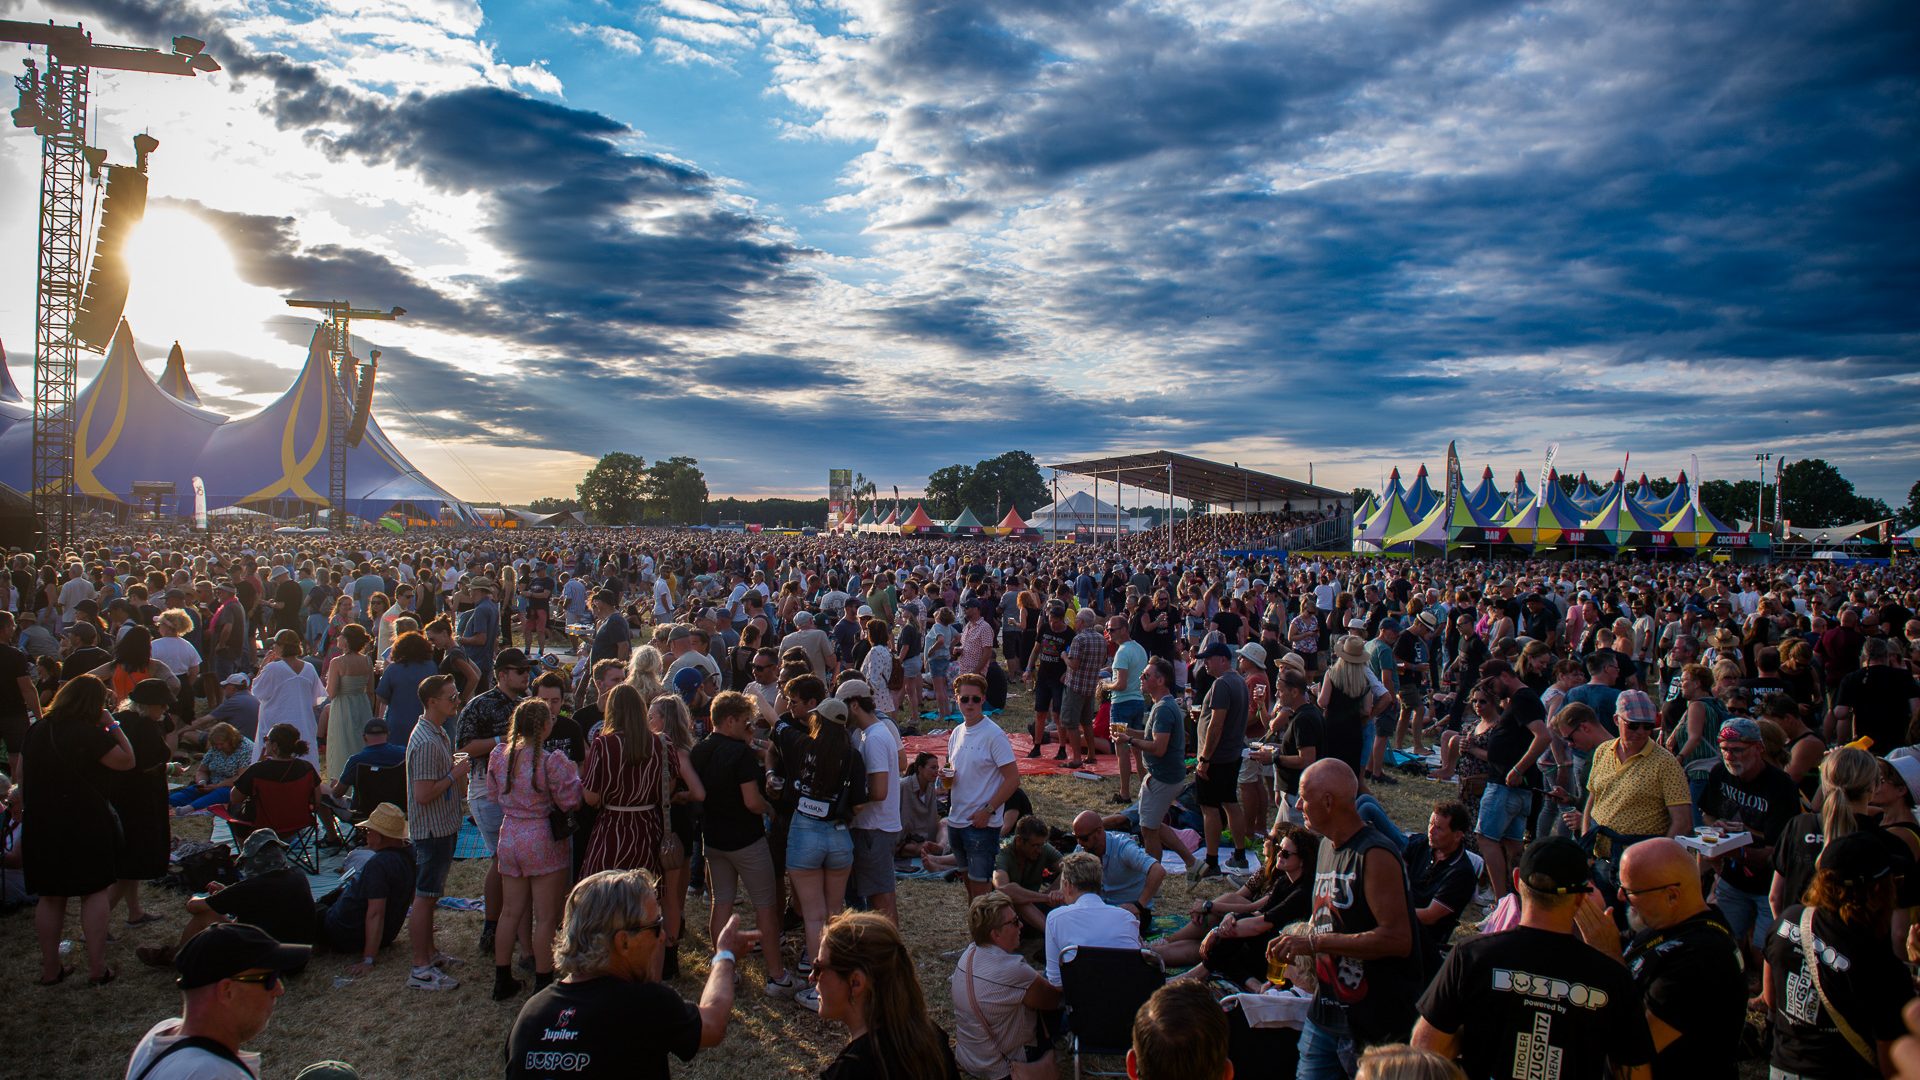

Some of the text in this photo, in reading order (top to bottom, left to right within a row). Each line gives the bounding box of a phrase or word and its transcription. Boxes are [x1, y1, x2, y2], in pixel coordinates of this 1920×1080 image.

[1484, 531, 1500, 540] BAR
[1570, 532, 1585, 542] BAR
[1651, 533, 1665, 543] BAR
[1717, 534, 1747, 545] COCKTAIL
[1787, 974, 1798, 1012] TIROLER
[1523, 999, 1567, 1015] powered by
[1806, 991, 1819, 1023] ARENA
[540, 1028, 579, 1042] Jupiler
[1530, 1014, 1550, 1080] ZUGSPITZ
[1515, 1034, 1529, 1078] TIROLER
